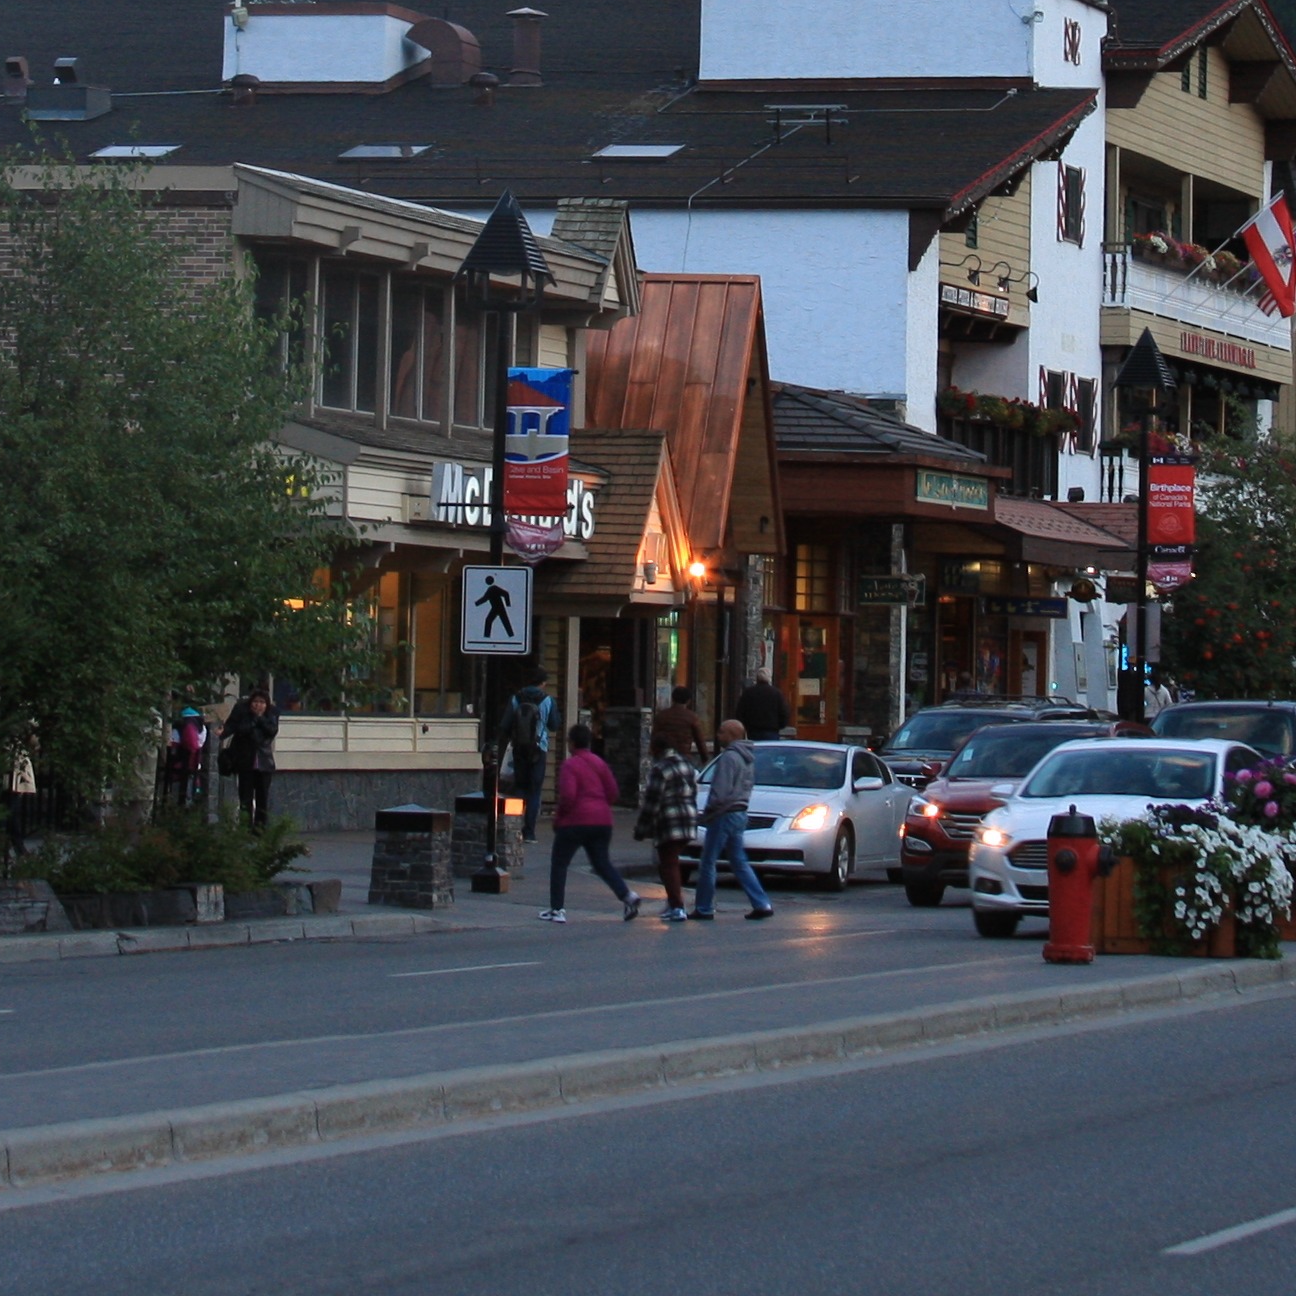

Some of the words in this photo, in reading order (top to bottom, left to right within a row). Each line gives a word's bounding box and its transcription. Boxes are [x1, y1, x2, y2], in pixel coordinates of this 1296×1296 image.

[527, 465, 541, 474] and
[543, 465, 564, 474] Basin
[1150, 483, 1192, 493] Birthplace
